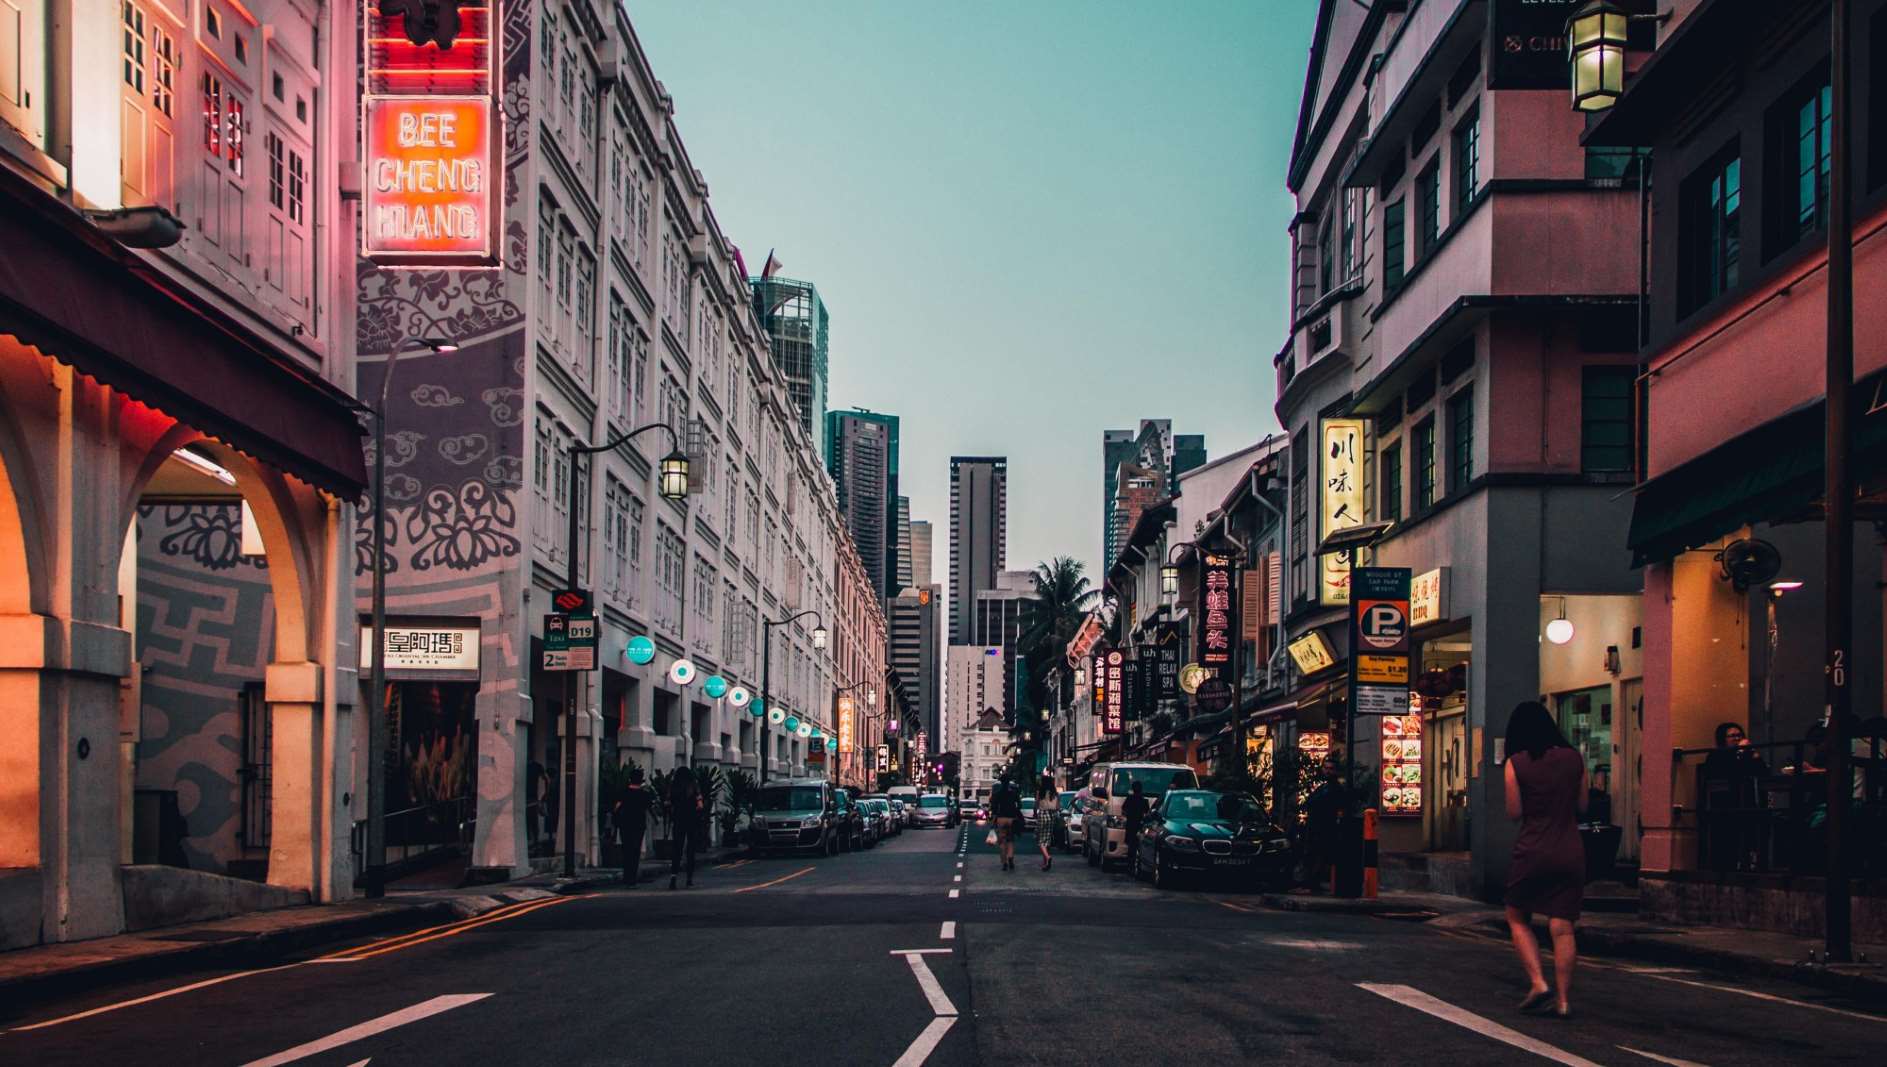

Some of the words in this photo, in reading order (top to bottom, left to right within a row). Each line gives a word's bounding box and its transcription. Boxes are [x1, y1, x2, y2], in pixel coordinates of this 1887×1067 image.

[398, 112, 457, 148] BEE
[375, 158, 481, 193] CHENG
[377, 204, 478, 239] HIANG
[1161, 649, 1175, 660] THAI
[1159, 664, 1177, 674] RELAX
[1162, 677, 1174, 688] SPA
